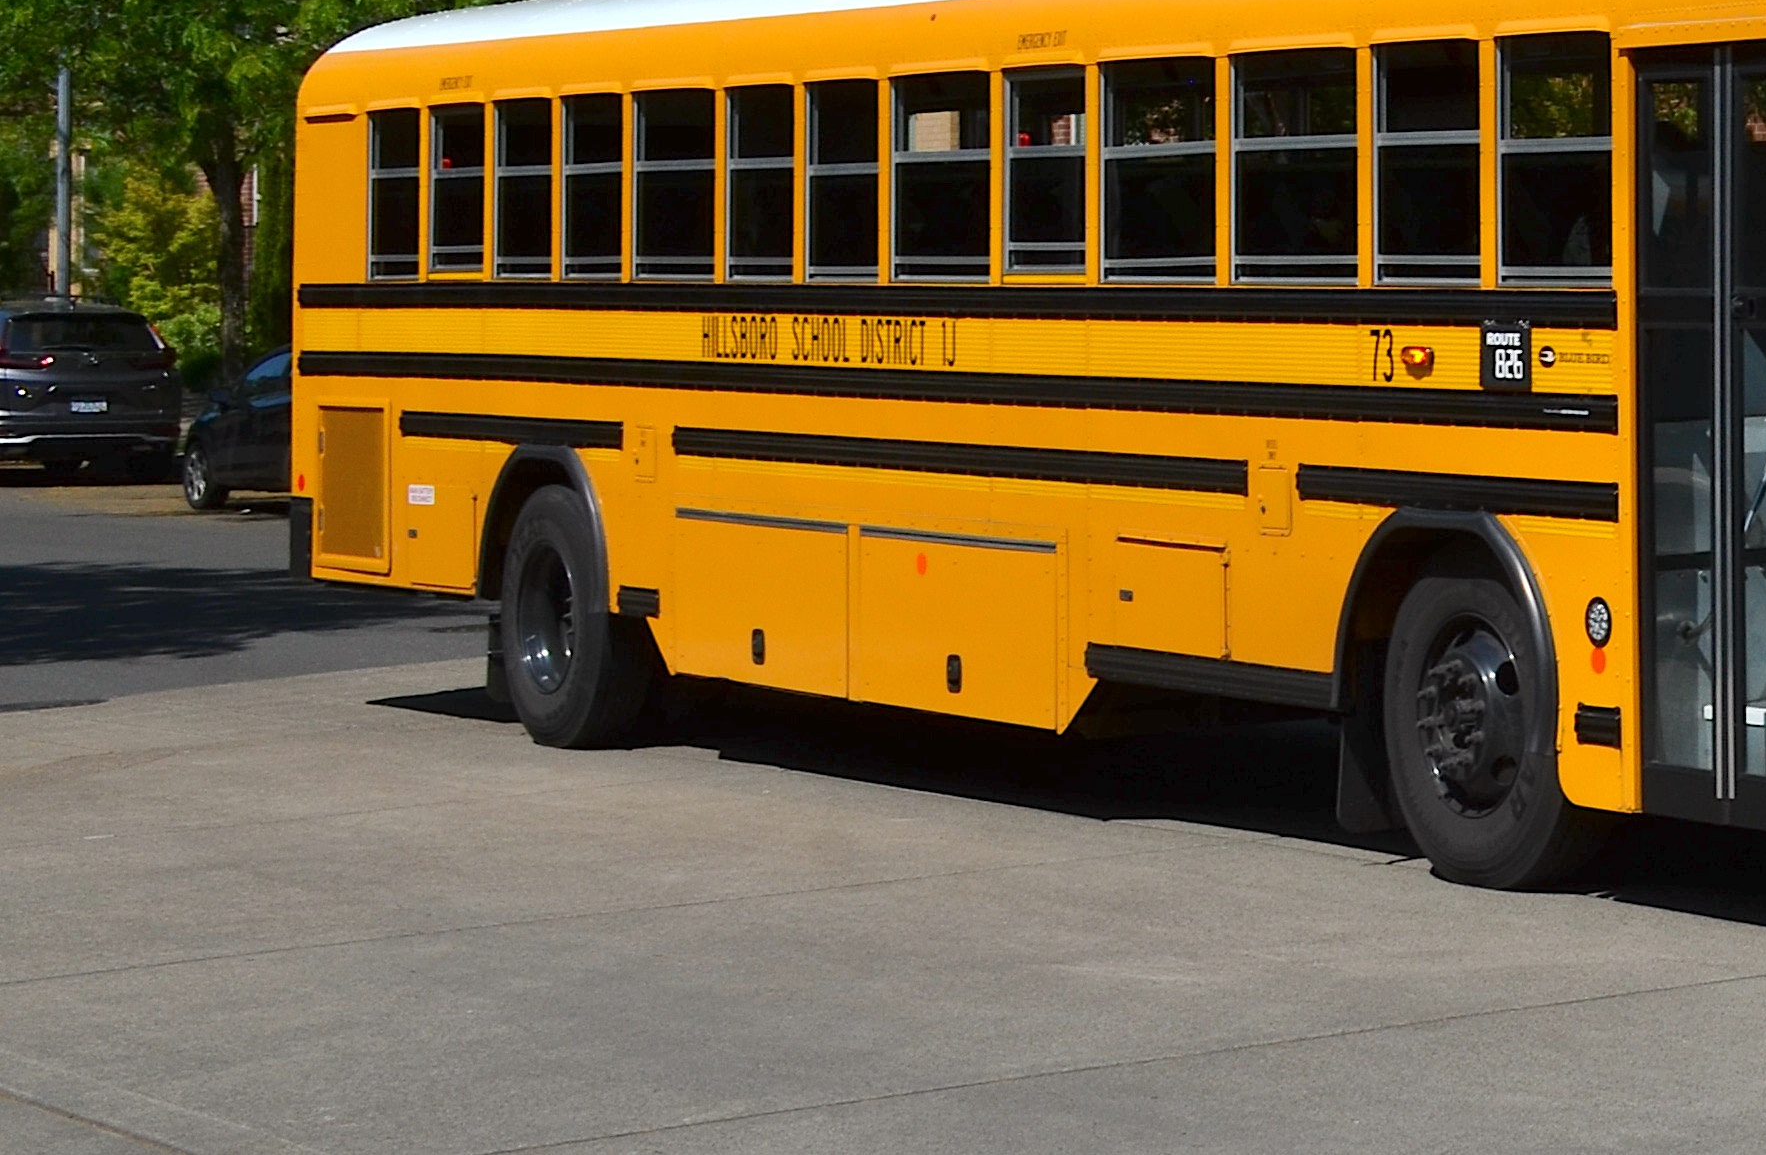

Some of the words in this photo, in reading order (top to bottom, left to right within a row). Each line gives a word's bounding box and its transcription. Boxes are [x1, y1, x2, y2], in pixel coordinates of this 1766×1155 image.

[702, 316, 778, 360] HILLSBORO
[792, 317, 849, 362] SCHOOL
[860, 319, 926, 366] DISTRICT
[1486, 332, 1521, 346] ROUTE
[1370, 329, 1394, 383] 73
[1495, 348, 1524, 379] 826
[1558, 352, 1584, 363] BLUE
[1585, 353, 1610, 364] BIRD
